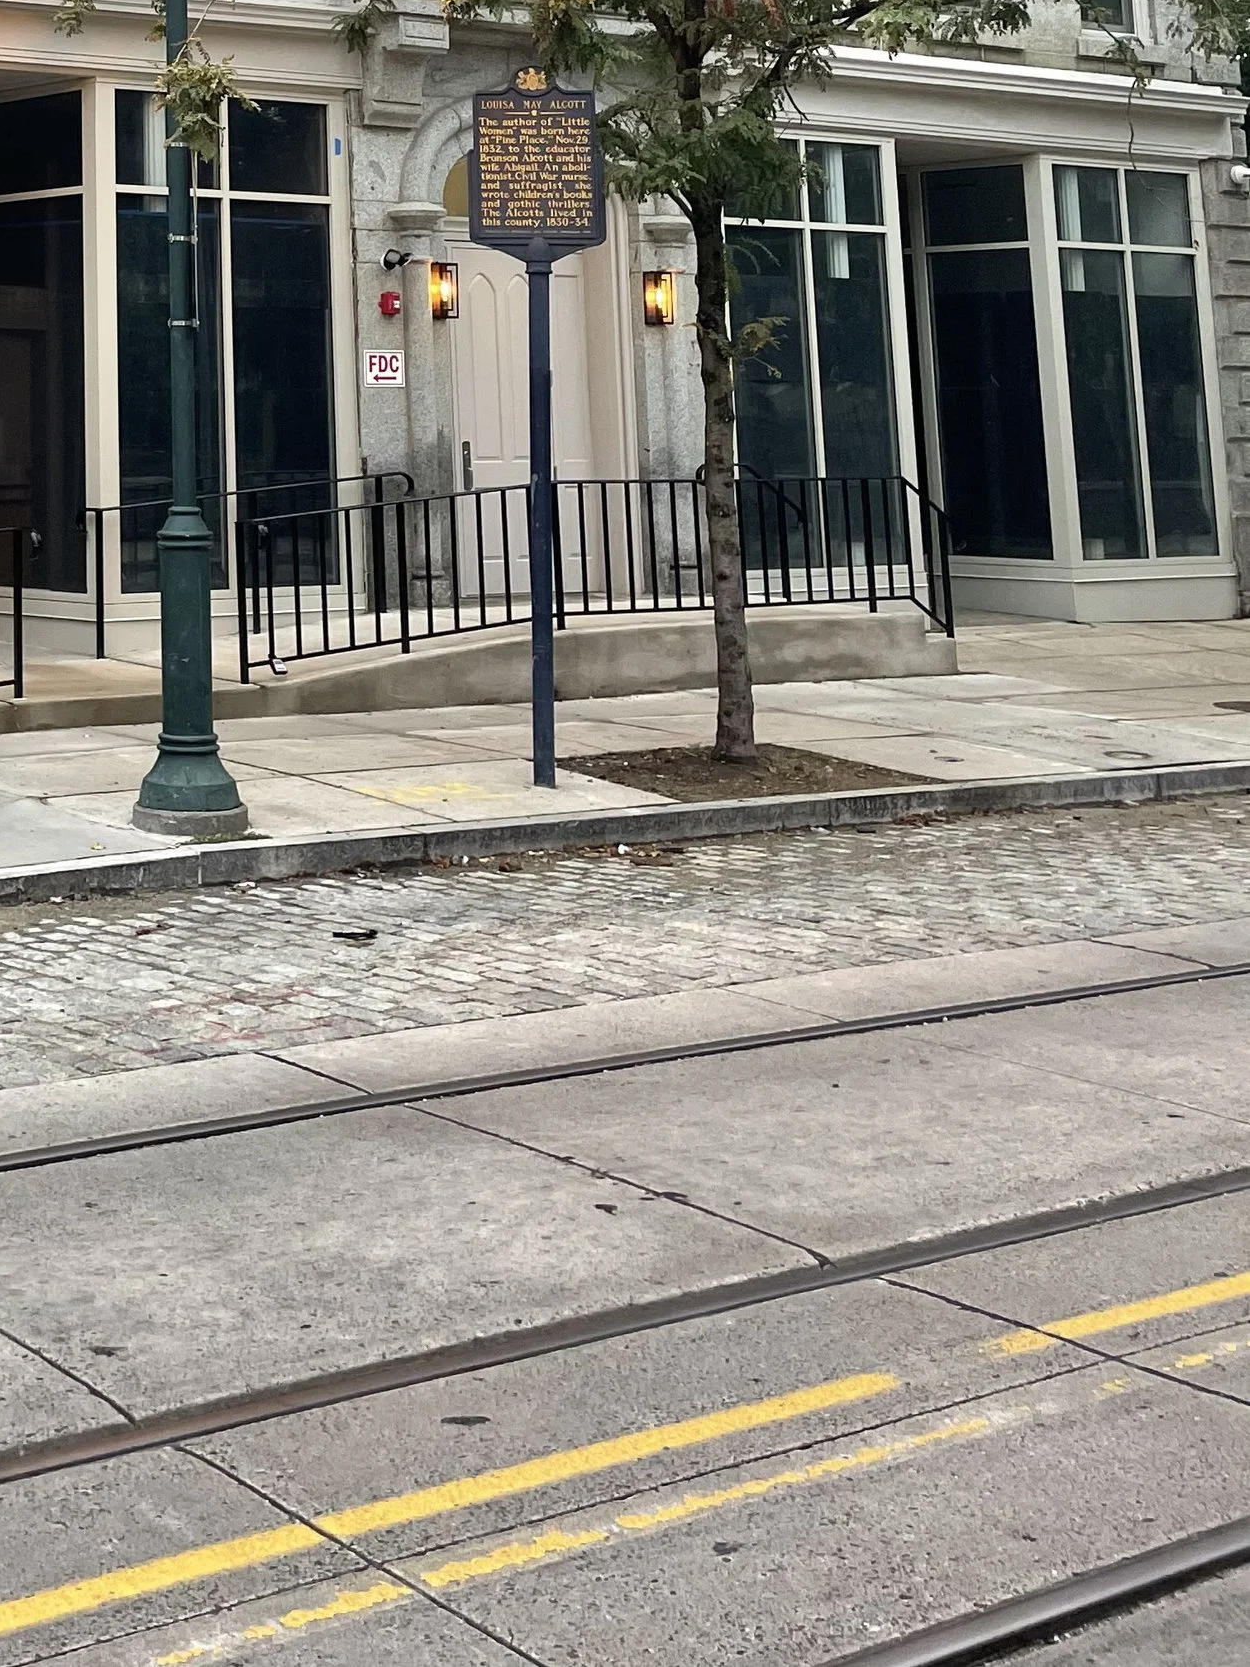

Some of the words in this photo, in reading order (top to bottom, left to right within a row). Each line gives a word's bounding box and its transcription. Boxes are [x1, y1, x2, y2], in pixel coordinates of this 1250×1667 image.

[481, 100, 514, 109] LOUISA
[523, 100, 542, 109] MAY
[550, 100, 587, 109] ALCOTT
[478, 117, 498, 126] The
[502, 117, 537, 126] author
[540, 117, 554, 126] of
[540, 126, 565, 135] born
[567, 126, 591, 135] here
[479, 136, 490, 144] at
[479, 145, 505, 153] 1832,
[508, 145, 520, 153] to
[524, 145, 541, 153] the
[545, 145, 591, 153] educator
[479, 153, 518, 162] Bronson
[522, 153, 553, 162] Alcott
[555, 153, 574, 162] and
[576, 153, 592, 162] his
[480, 162, 500, 171] wife
[543, 162, 559, 171] An
[562, 162, 591, 171] aboli-
[539, 172, 558, 181] War
[480, 181, 500, 189] and
[508, 181, 566, 191] suffragist,
[574, 181, 592, 189] she
[481, 191, 510, 199] wrote
[513, 190, 560, 199] children's
[563, 190, 593, 199] books
[480, 199, 500, 208] and
[507, 199, 540, 209] gothic
[481, 208, 502, 217] The
[505, 208, 544, 217] Alcotts
[550, 208, 576, 217] lived
[582, 208, 593, 217] in
[481, 217, 501, 226] this
[368, 354, 400, 373] FDC
